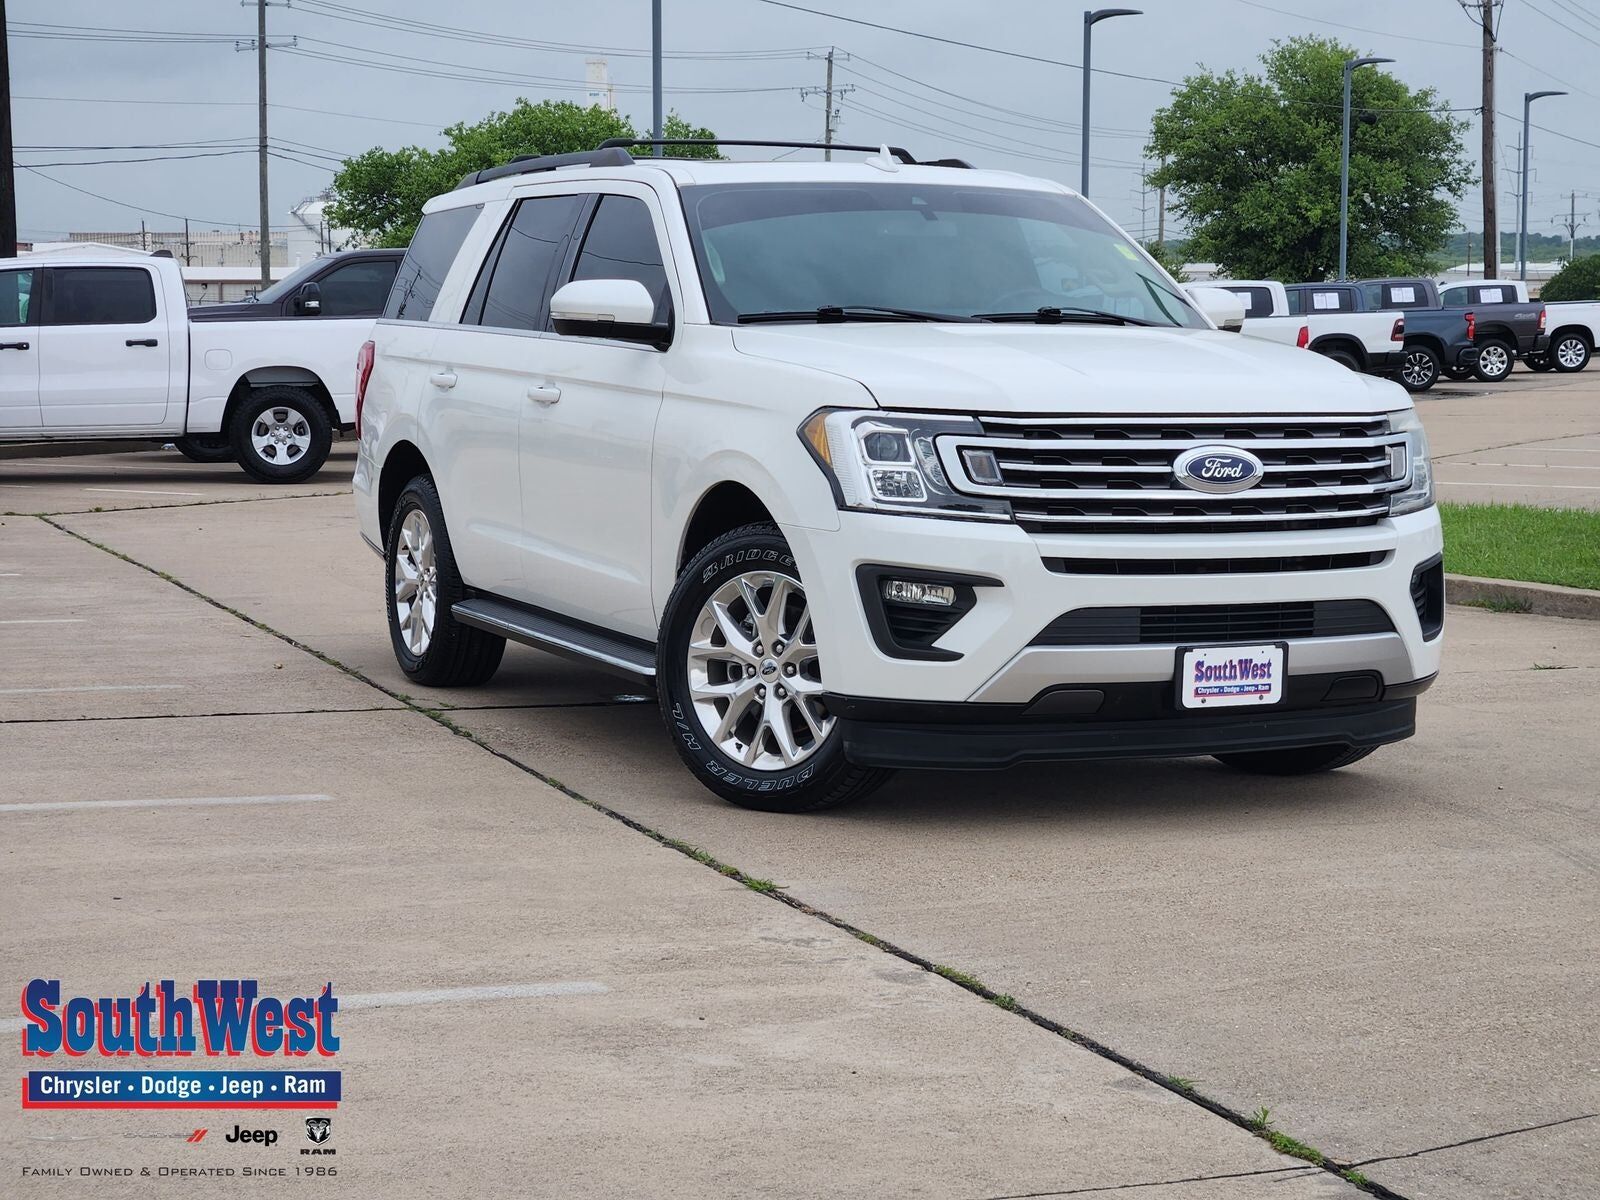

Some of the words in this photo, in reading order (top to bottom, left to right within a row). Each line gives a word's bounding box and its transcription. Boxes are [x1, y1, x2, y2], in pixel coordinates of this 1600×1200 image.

[1201, 457, 1243, 478] Ford
[702, 549, 799, 584] BRIDGE
[1194, 659, 1272, 682] SouthWest
[705, 761, 815, 792] DUELER
